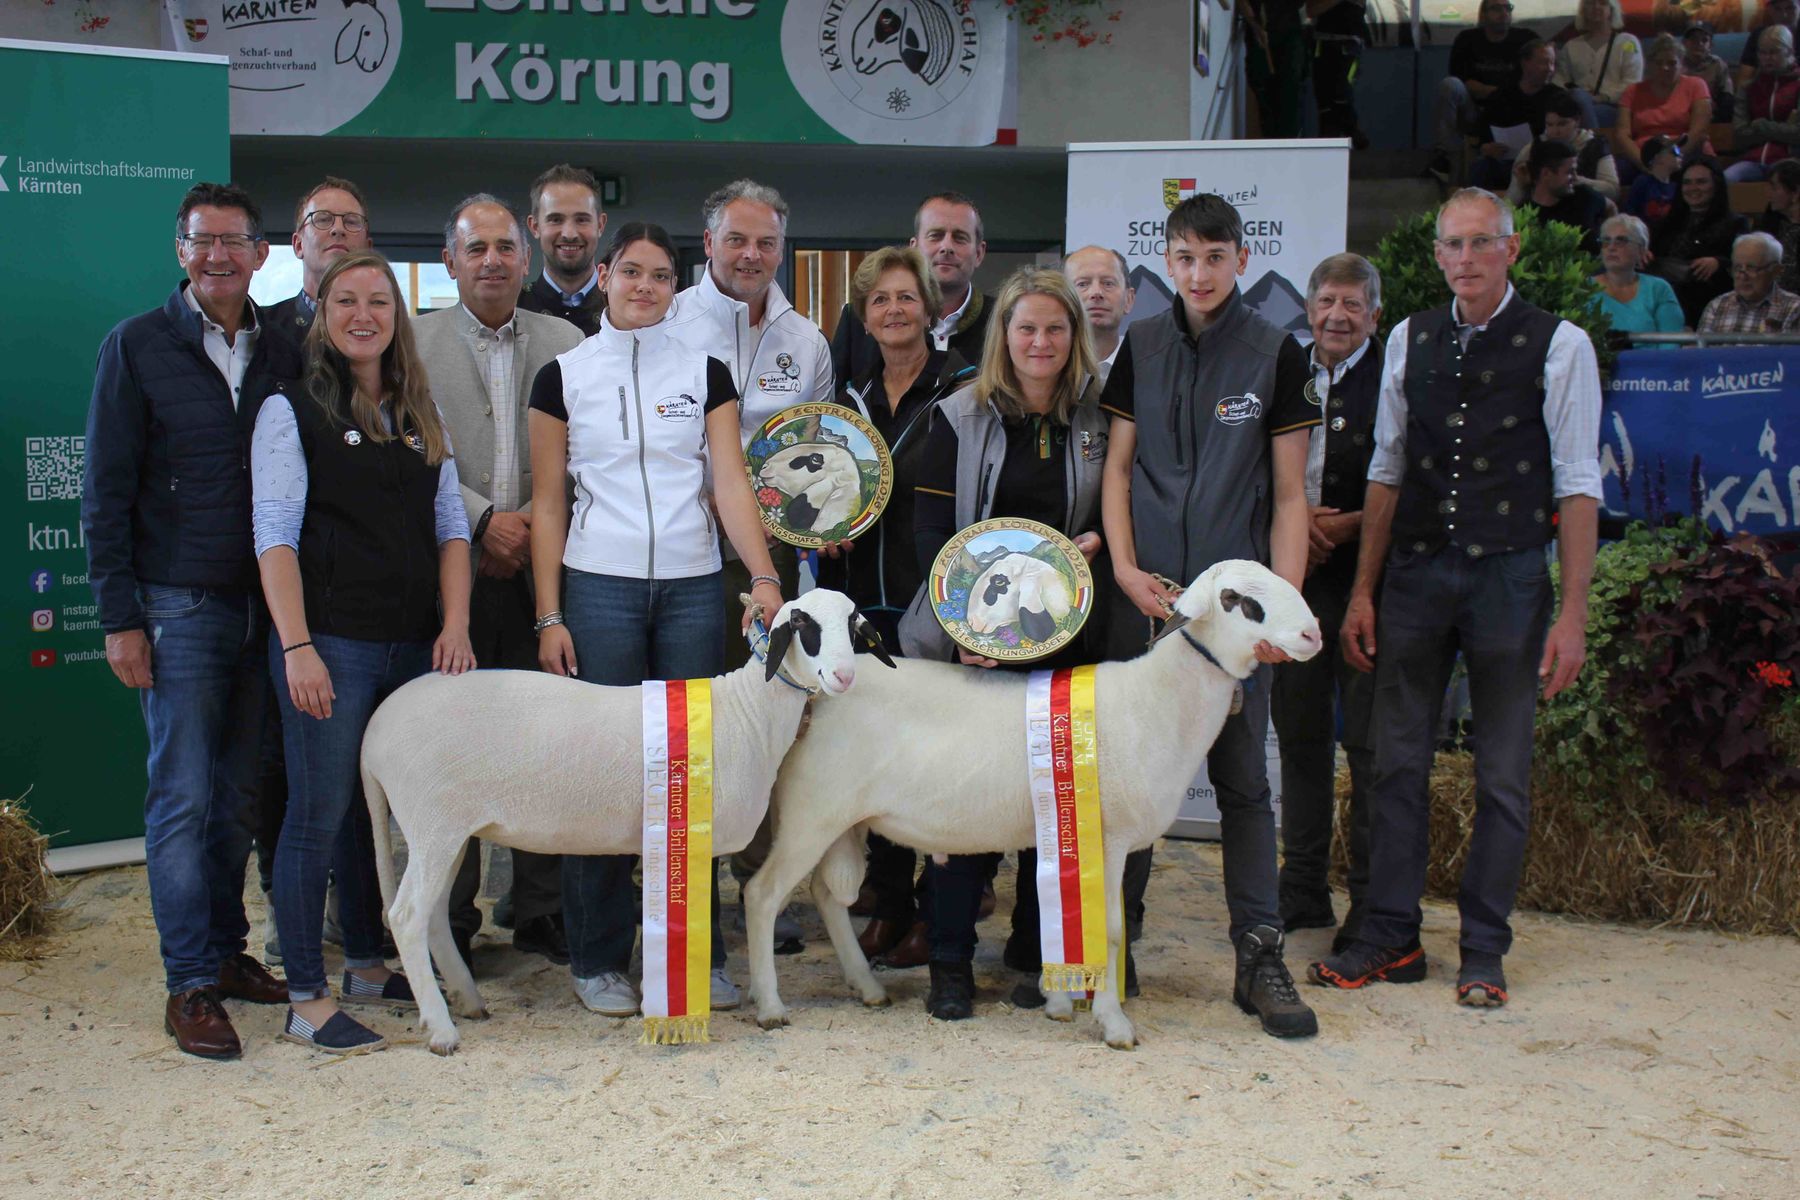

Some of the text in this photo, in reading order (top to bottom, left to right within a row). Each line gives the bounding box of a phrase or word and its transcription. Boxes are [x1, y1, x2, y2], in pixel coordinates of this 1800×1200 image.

[229, 61, 317, 71] genzuchtverband
[240, 47, 293, 57] Schaf- und
[455, 42, 730, 120] Körung
[18, 156, 195, 180] Landwirtschaftskammer
[19, 177, 82, 195] Kärnten
[793, 406, 864, 428] ZENTRALE
[939, 523, 994, 568] ZENTRALE
[1062, 544, 1088, 579] 2026
[950, 626, 1068, 657] SIEGER JUNGWIDDER
[646, 747, 667, 833] SIEGER
[1053, 712, 1078, 860] Kärntner Brillenschaf
[670, 759, 686, 906] Kärntner Brillenschaf
